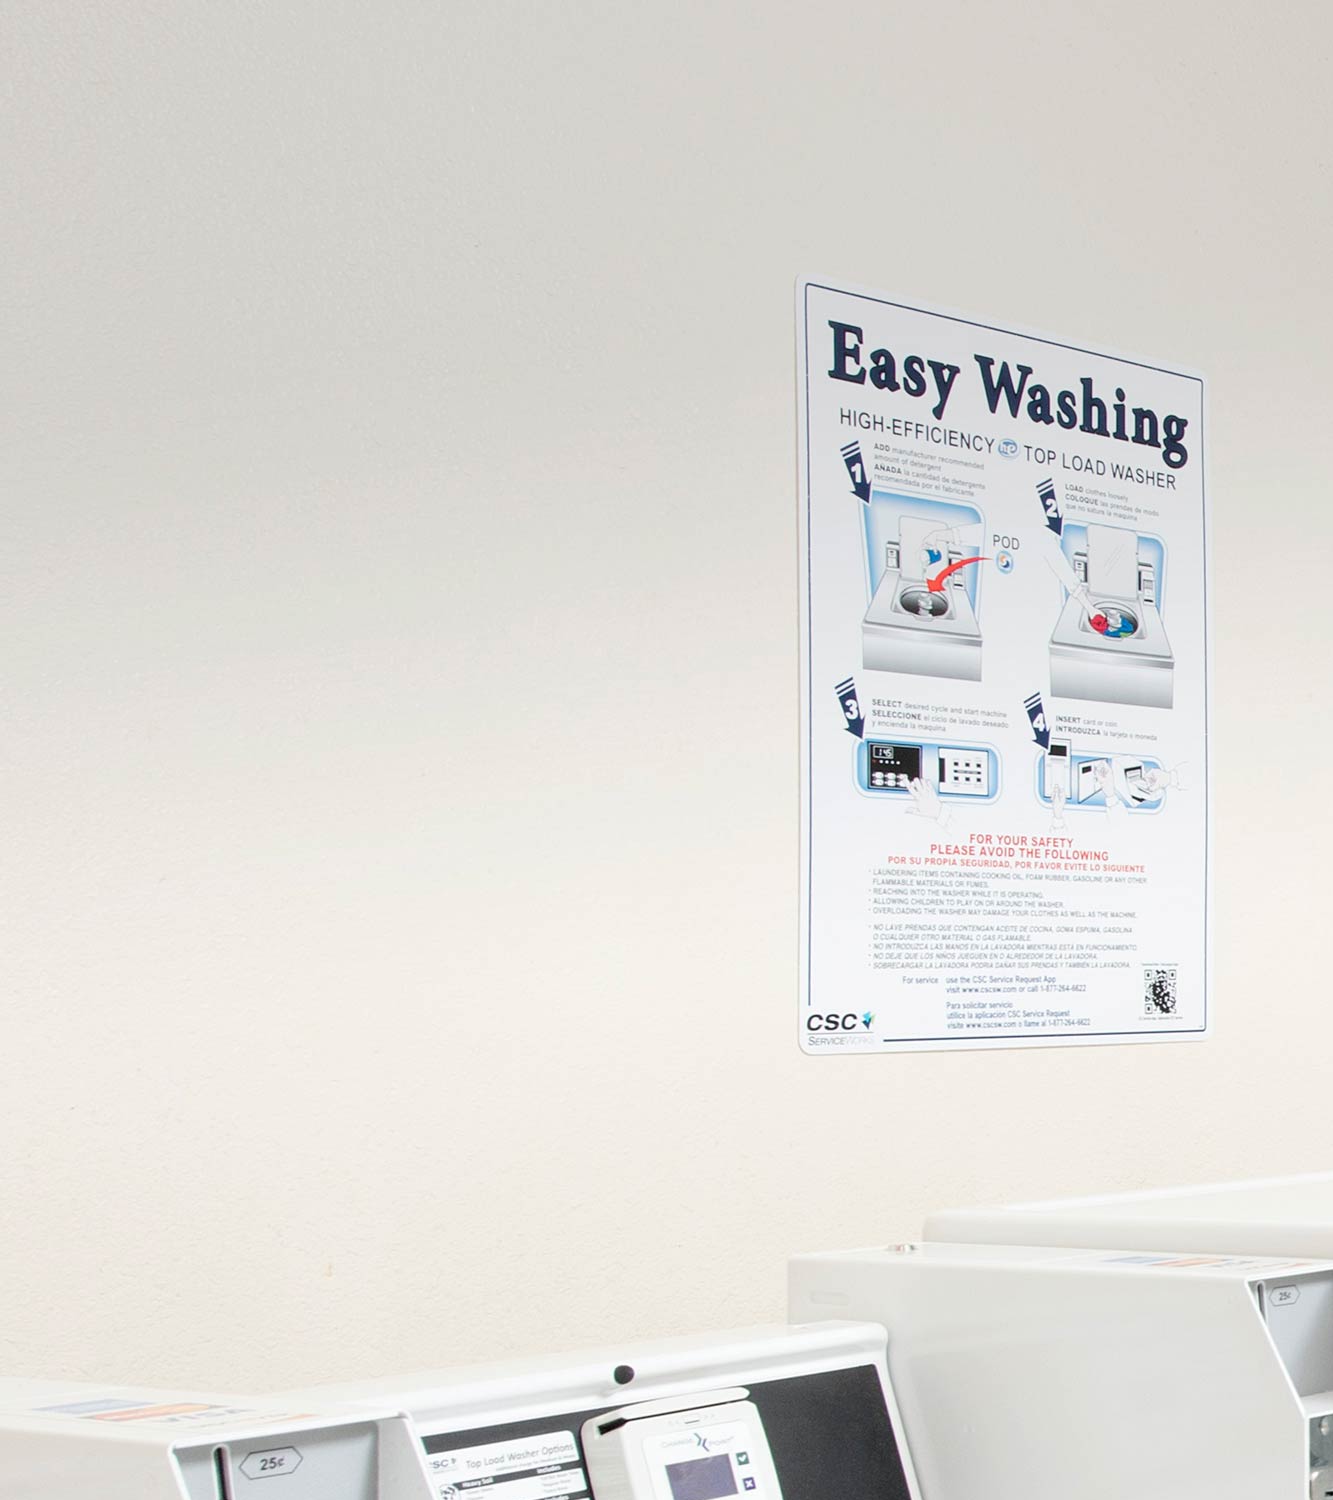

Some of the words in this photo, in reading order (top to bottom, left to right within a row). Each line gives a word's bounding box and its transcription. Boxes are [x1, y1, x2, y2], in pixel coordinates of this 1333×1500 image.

[828, 320, 960, 420] Easy
[974, 354, 1188, 468] Washing
[840, 408, 995, 455] HIGH-EFFICIENCY
[1024, 446, 1056, 467] TOP
[1063, 455, 1106, 477] LOAD
[1111, 464, 1177, 490] WASHER
[873, 443, 890, 452] ADD
[851, 463, 862, 483] 1
[1065, 484, 1083, 493] LOAD
[1065, 493, 1098, 506] COLOQUE
[1045, 498, 1058, 518] 2
[993, 534, 1020, 550] POD
[845, 699, 858, 720] 3
[872, 699, 902, 708] SELECT
[904, 702, 929, 711] desired
[931, 705, 948, 714] cycle
[950, 706, 962, 714] and
[964, 707, 979, 716] start
[872, 709, 921, 721] SELECCIONE
[1032, 713, 1047, 732] 4
[1056, 715, 1081, 724] INSERT
[1056, 725, 1101, 736] INTRODUZCA
[969, 833, 993, 845] FOR
[997, 835, 1028, 846] YOUR
[1031, 836, 1074, 848] SAFETY
[930, 844, 976, 856] PLEASE
[979, 846, 1015, 857] AVOID
[1019, 847, 1041, 859] THE
[1045, 849, 1109, 861] FOLLOWING
[888, 856, 906, 865] POR
[909, 856, 922, 865] SU
[924, 857, 957, 866] PROPIA
[960, 858, 1013, 869] SEGURIDAD,
[1015, 861, 1032, 869] POR
[1034, 862, 1061, 870] FAVOR
[1064, 863, 1087, 871] EVITE
[1090, 864, 1101, 872] LO
[1103, 864, 1145, 873] SIGUIENTE
[873, 869, 917, 877] LAUNDERING
[916, 879, 953, 887] MATERIALS
[902, 976, 913, 984] For
[1015, 975, 1042, 984] Request
[1023, 1010, 1044, 1018] Service
[1046, 1009, 1070, 1018] Request
[806, 1013, 858, 1031] CSC
[260, 1457, 285, 1471] 25¢
[430, 1458, 449, 1469] SC
[466, 1459, 482, 1469] Top
[484, 1455, 505, 1466] Load
[507, 1449, 539, 1461] Washer
[542, 1444, 574, 1457] Options
